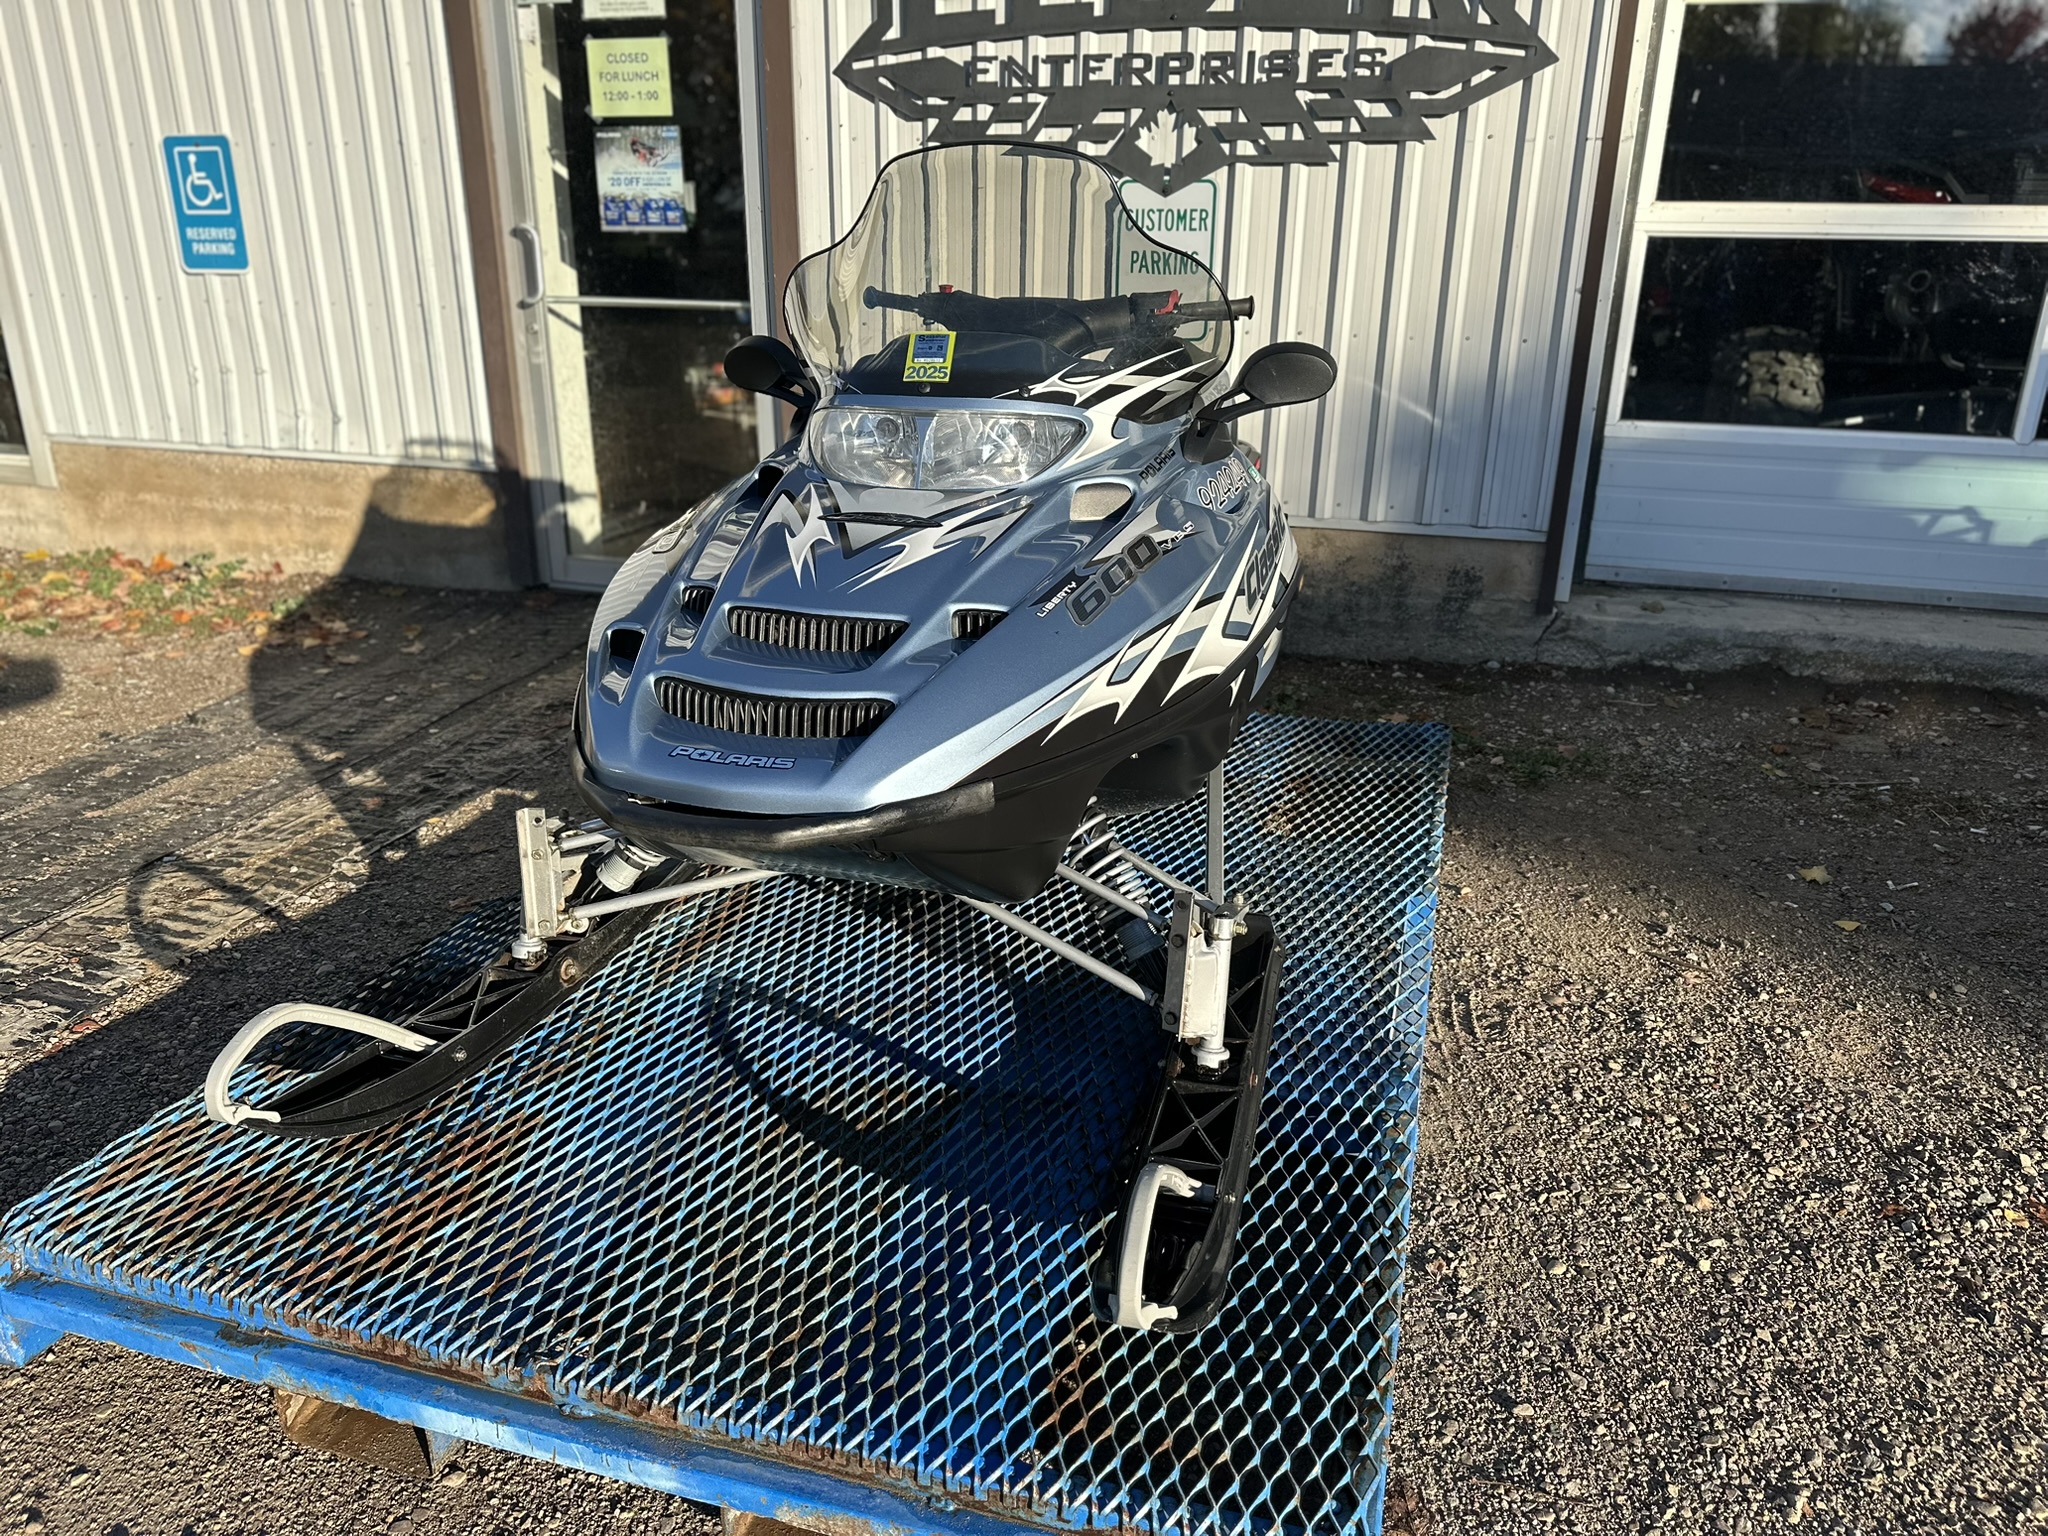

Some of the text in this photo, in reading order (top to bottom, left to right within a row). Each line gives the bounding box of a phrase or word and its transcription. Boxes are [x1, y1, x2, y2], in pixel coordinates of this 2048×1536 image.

[607, 53, 649, 63] CLOSED
[968, 48, 1387, 87] ENTERPRISES
[599, 72, 659, 82] FOR LUNCH
[603, 91, 629, 101] 12:00
[638, 91, 659, 101] 1:00
[624, 177, 641, 187] OFF
[1125, 208, 1209, 232] CUSTOMER
[186, 227, 237, 240] RESERVED
[192, 242, 235, 255] PARKING
[1130, 250, 1199, 275] PARKING
[905, 366, 948, 380] 2025
[1138, 448, 1176, 484] POLARIS
[1244, 503, 1287, 614] Classic
[1035, 581, 1078, 618] LIBERTY
[1065, 533, 1164, 627] 600
[669, 745, 797, 770] POLARIS
